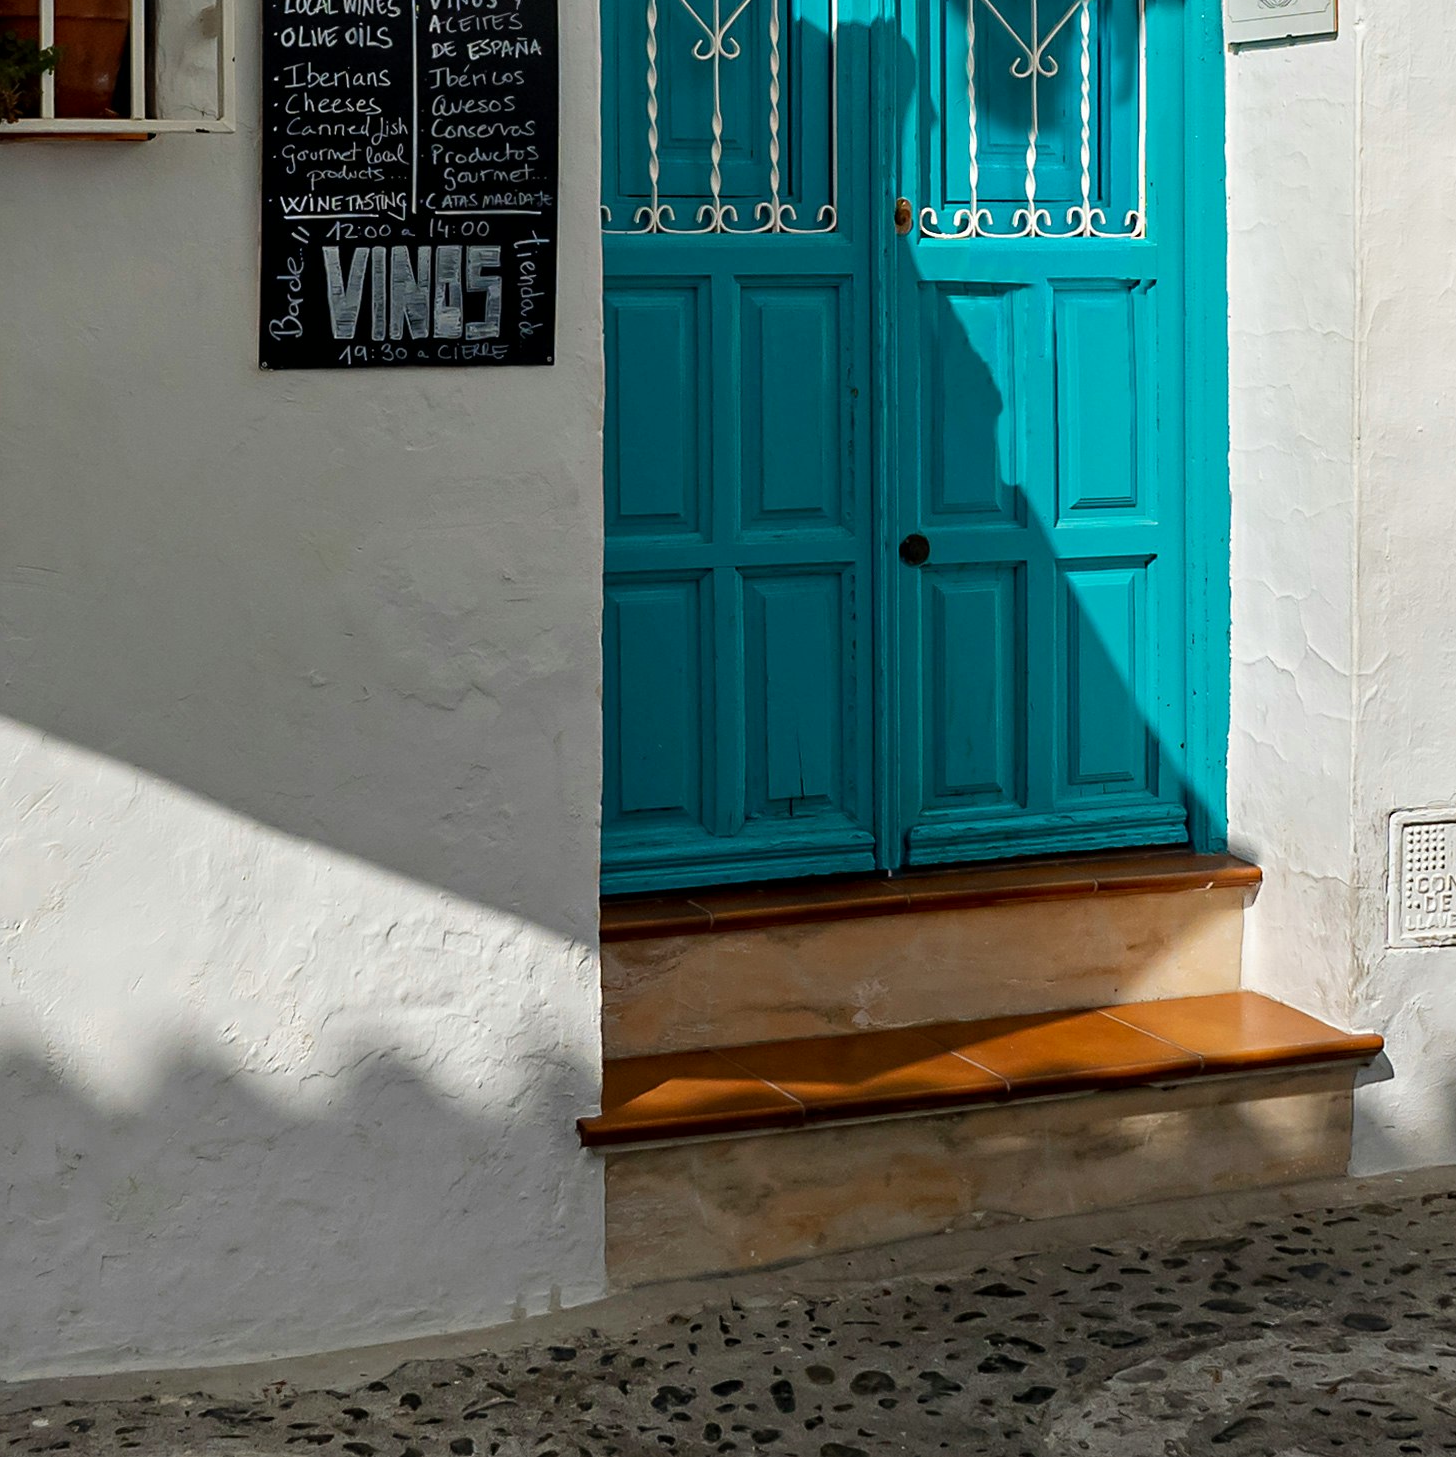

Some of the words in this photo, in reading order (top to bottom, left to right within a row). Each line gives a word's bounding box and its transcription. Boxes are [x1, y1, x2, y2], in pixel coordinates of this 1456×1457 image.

[429, 12, 523, 34] ACEITES
[280, 25, 340, 47] OLIVE
[431, 40, 457, 59] DE
[467, 37, 542, 60] ESPAÑA
[283, 62, 391, 88] Iberians
[428, 64, 525, 89] Ibéricos
[285, 92, 382, 115] Cheeses
[431, 94, 516, 116] Quesos
[286, 116, 370, 136] Canned
[371, 117, 408, 145] fish
[431, 118, 535, 139] Conservas
[366, 143, 410, 165] local
[431, 142, 539, 164] Productos
[425, 193, 478, 210] CATAS
[326, 220, 392, 241] 12:00
[429, 218, 490, 238] 14:00
[322, 245, 503, 342] VINOS
[338, 343, 408, 365] 19:30
[1425, 894, 1452, 914] DE
